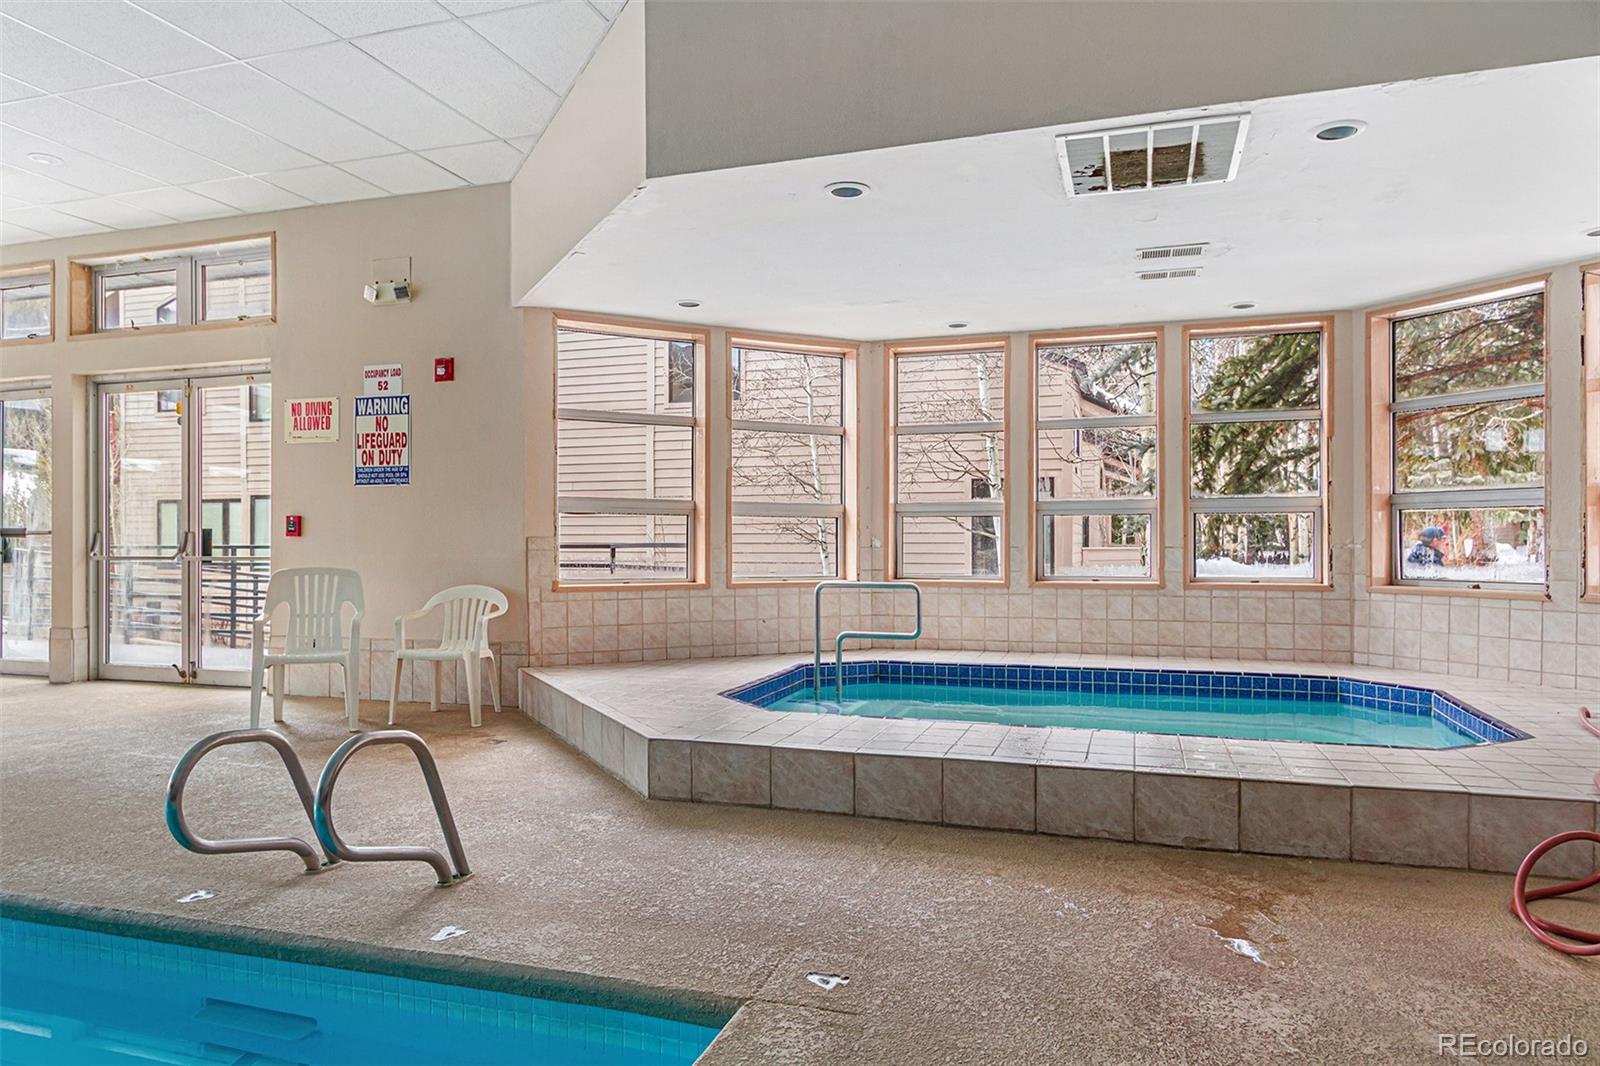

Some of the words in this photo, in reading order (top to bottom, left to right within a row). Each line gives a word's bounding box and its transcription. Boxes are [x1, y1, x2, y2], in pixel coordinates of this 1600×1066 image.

[364, 369, 389, 379] OCCUPANCY
[390, 367, 402, 377] LOAD
[378, 380, 389, 391] 52
[291, 402, 302, 417] NO
[305, 400, 333, 417] DIVING
[357, 397, 409, 415] WARNING
[293, 415, 331, 431] ALLOWED
[375, 415, 389, 432] NO
[356, 432, 408, 449] LIFEGUARD
[361, 449, 375, 466] ON
[378, 449, 403, 465] DUTY
